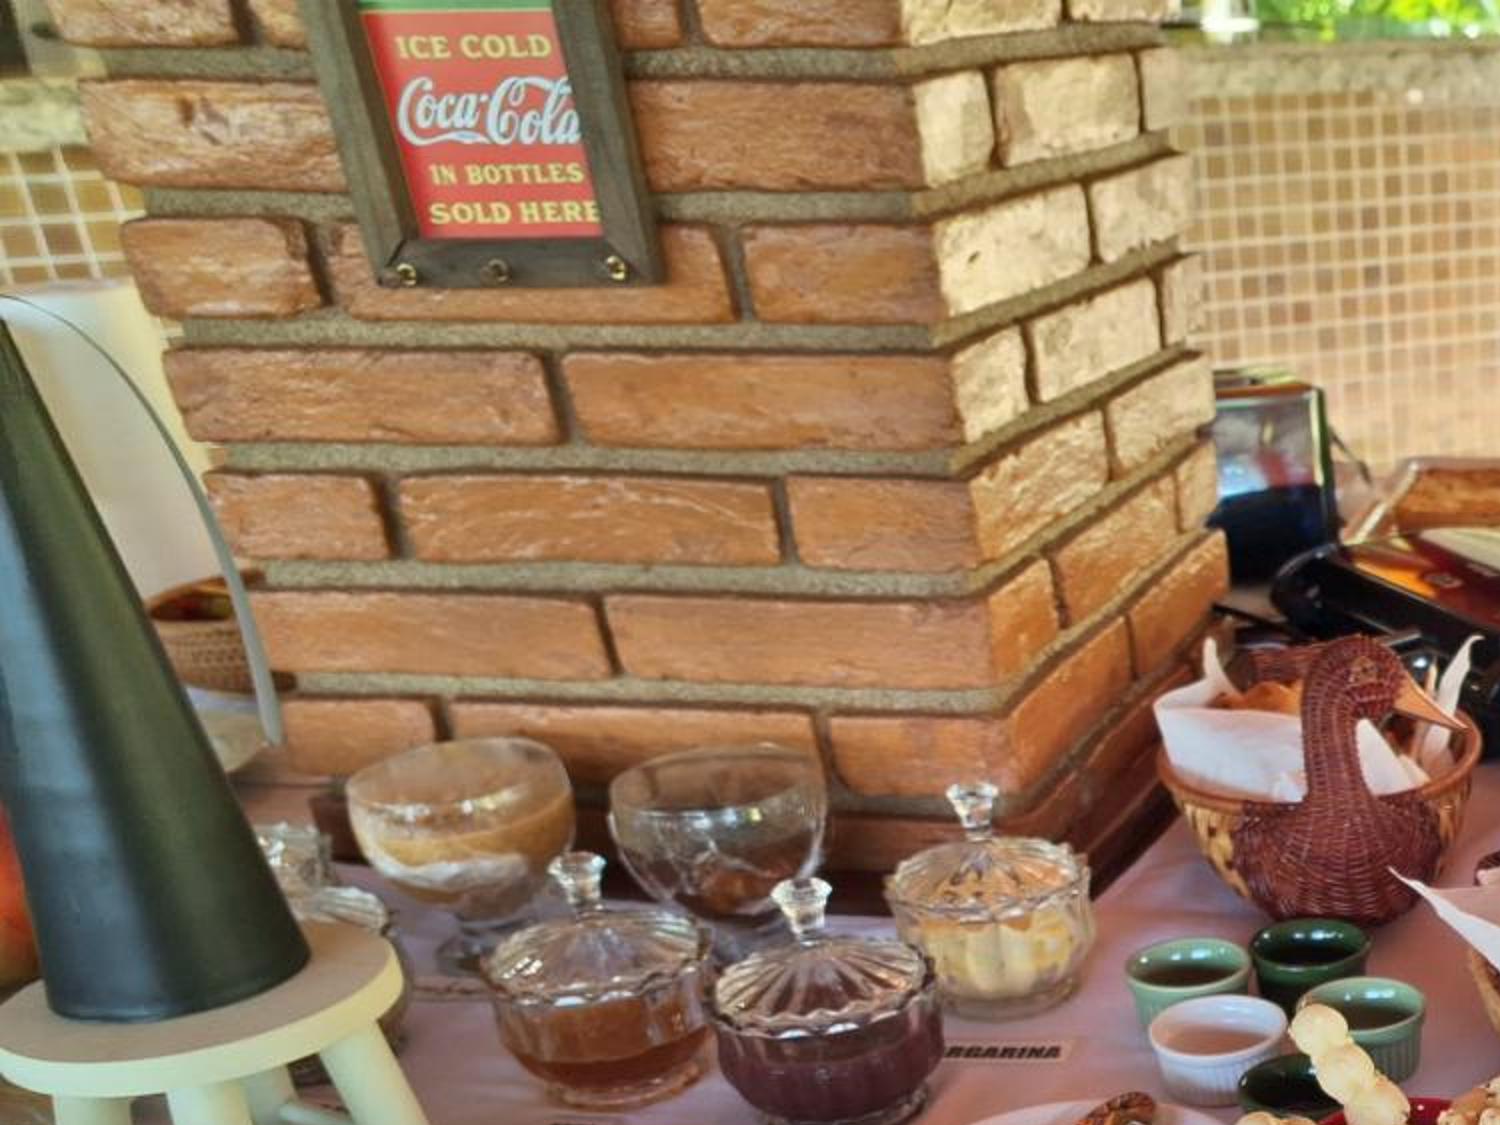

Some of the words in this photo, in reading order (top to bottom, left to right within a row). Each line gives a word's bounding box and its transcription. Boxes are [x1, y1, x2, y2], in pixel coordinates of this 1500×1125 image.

[395, 35, 451, 59] ICE
[460, 34, 551, 59] COLD
[429, 164, 457, 185] IN
[464, 162, 585, 185] BOTTLES
[429, 202, 512, 224] SOLD
[520, 200, 601, 224] HERE
[944, 1045, 1062, 1059] RGARINA
